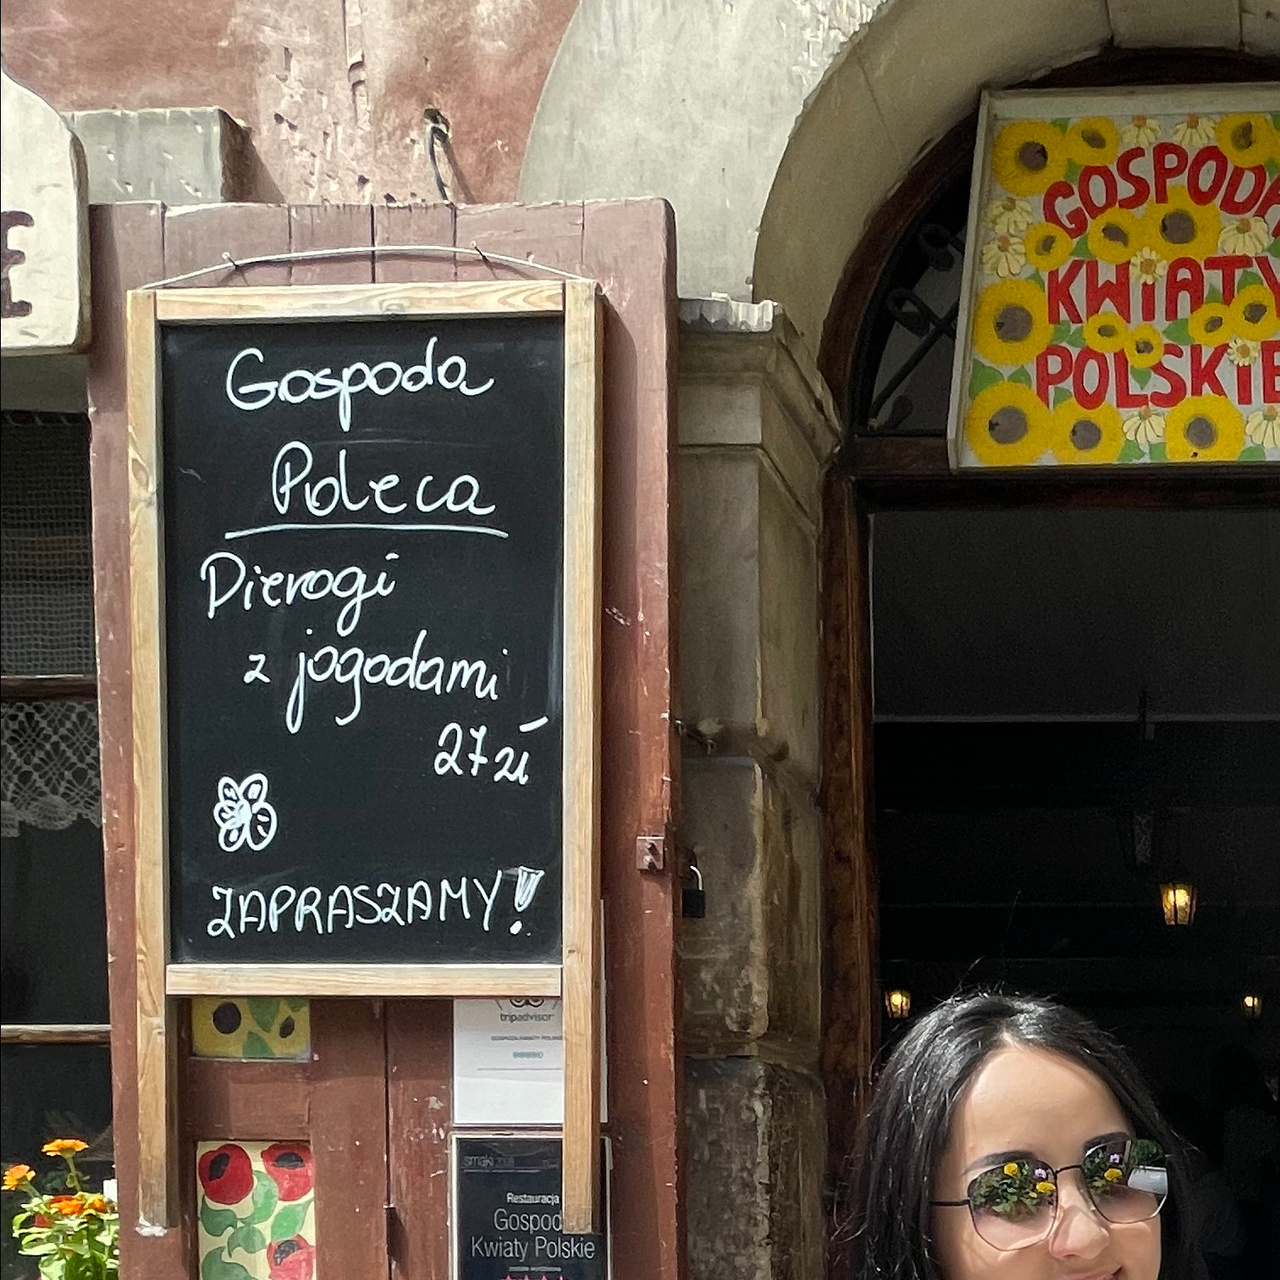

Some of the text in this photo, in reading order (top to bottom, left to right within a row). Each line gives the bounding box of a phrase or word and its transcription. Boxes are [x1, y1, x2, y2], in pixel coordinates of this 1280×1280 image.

[226, 337, 494, 431] Gospoda
[272, 441, 496, 517] Poleca
[243, 652, 270, 684] z
[434, 724, 486, 775] 27
[499, 1012, 553, 1024] tripadvisor
[506, 1192, 560, 1205] Restauracja
[493, 1208, 562, 1234] Gospod
[471, 1236, 595, 1262] Kwiaty Polskie
